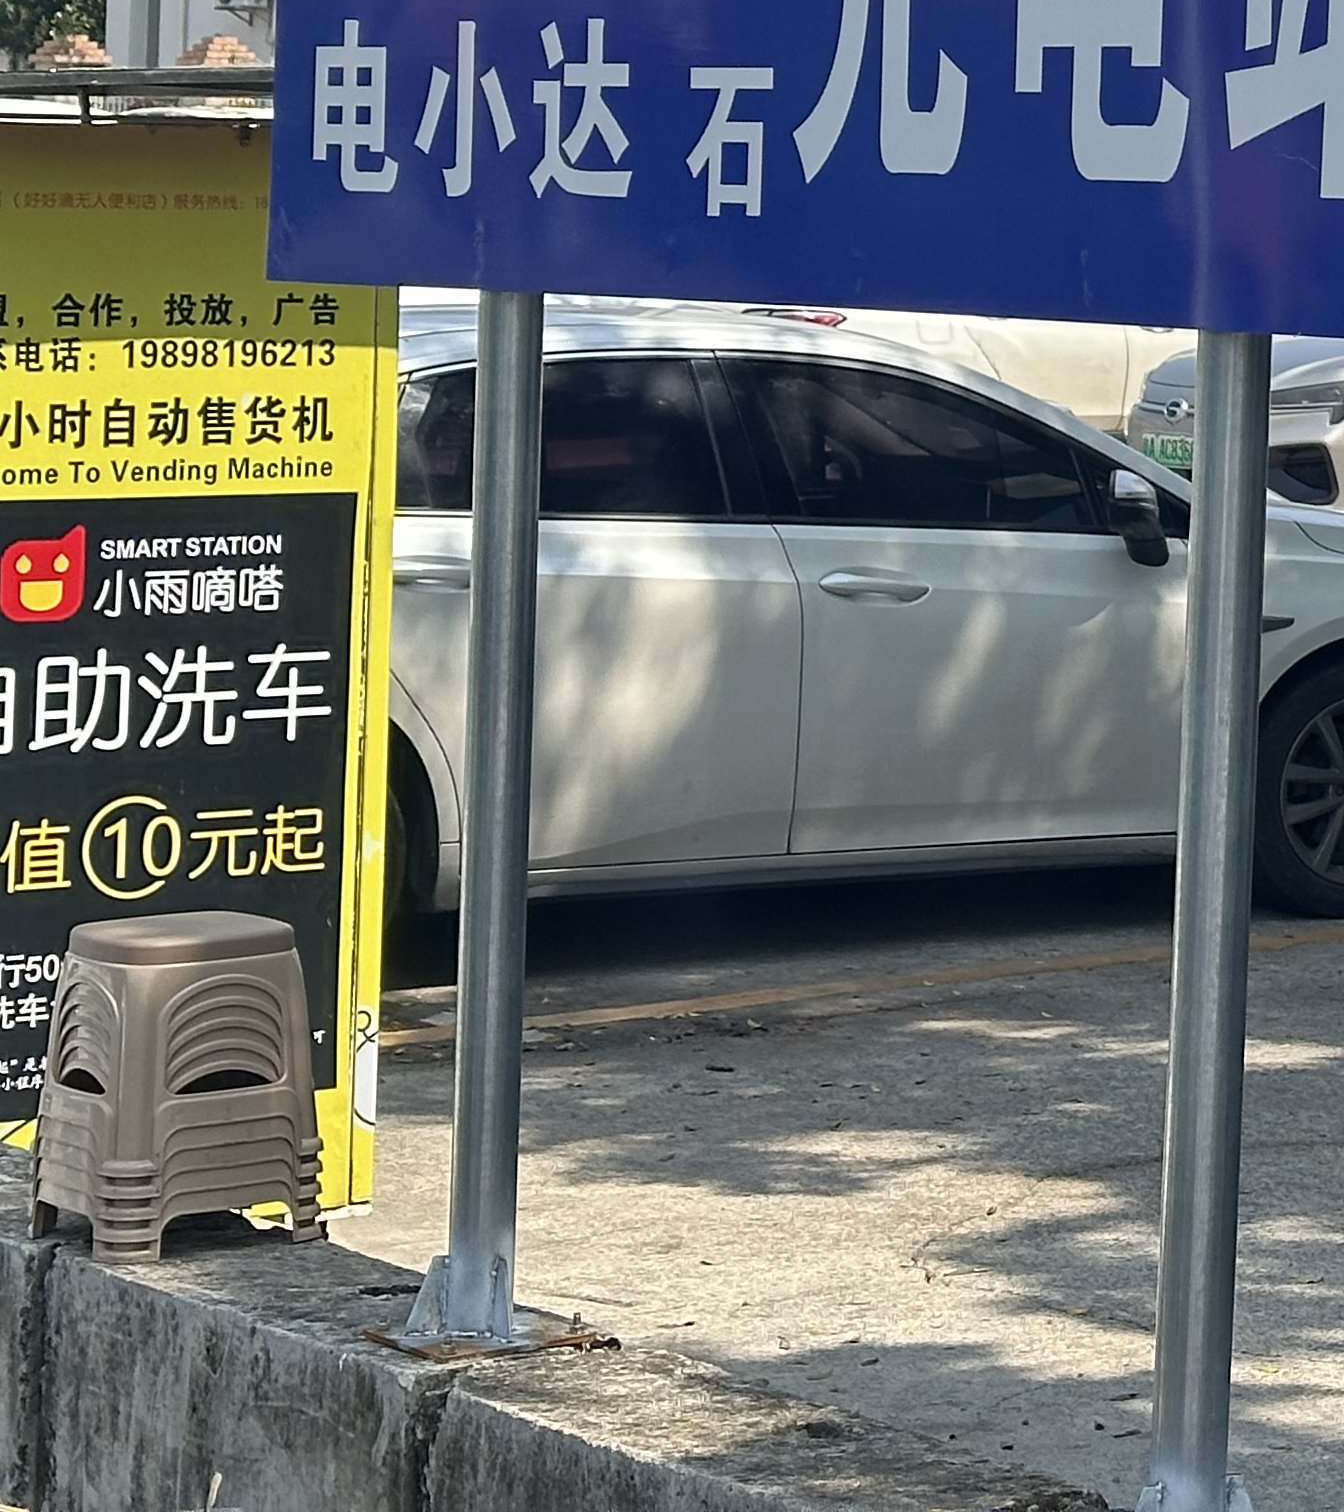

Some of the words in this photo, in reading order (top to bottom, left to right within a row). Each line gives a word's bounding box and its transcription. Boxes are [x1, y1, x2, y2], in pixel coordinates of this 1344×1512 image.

[312, 18, 633, 199] 电小达
[0, 394, 334, 449] 小时自动售货机
[68, 460, 101, 484] To
[112, 458, 218, 485] Vending
[228, 455, 334, 480] Machine
[101, 536, 181, 560] SMART
[186, 534, 282, 558] STATION
[0, 644, 332, 755] 助洗车
